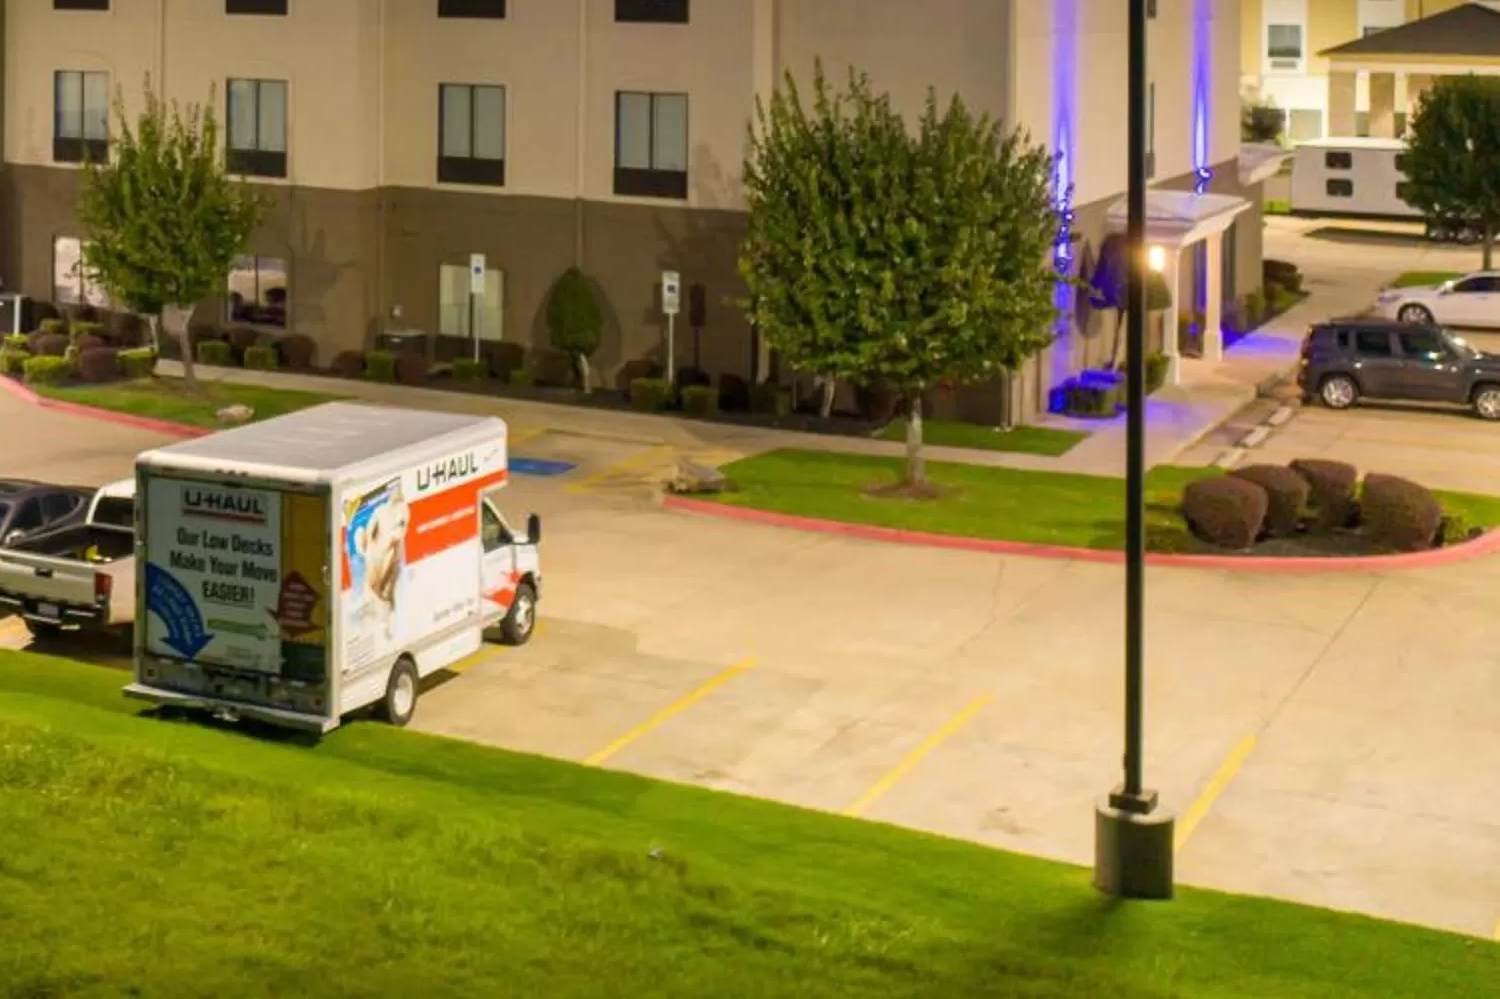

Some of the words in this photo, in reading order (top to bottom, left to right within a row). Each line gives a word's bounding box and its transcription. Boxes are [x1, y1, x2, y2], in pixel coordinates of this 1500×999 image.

[176, 527, 200, 546] Our
[203, 531, 229, 551] Low
[232, 534, 273, 557] Decks
[170, 551, 205, 571] Make
[210, 555, 238, 576] Your
[242, 560, 277, 582] Move
[203, 581, 255, 601] EASIER!
